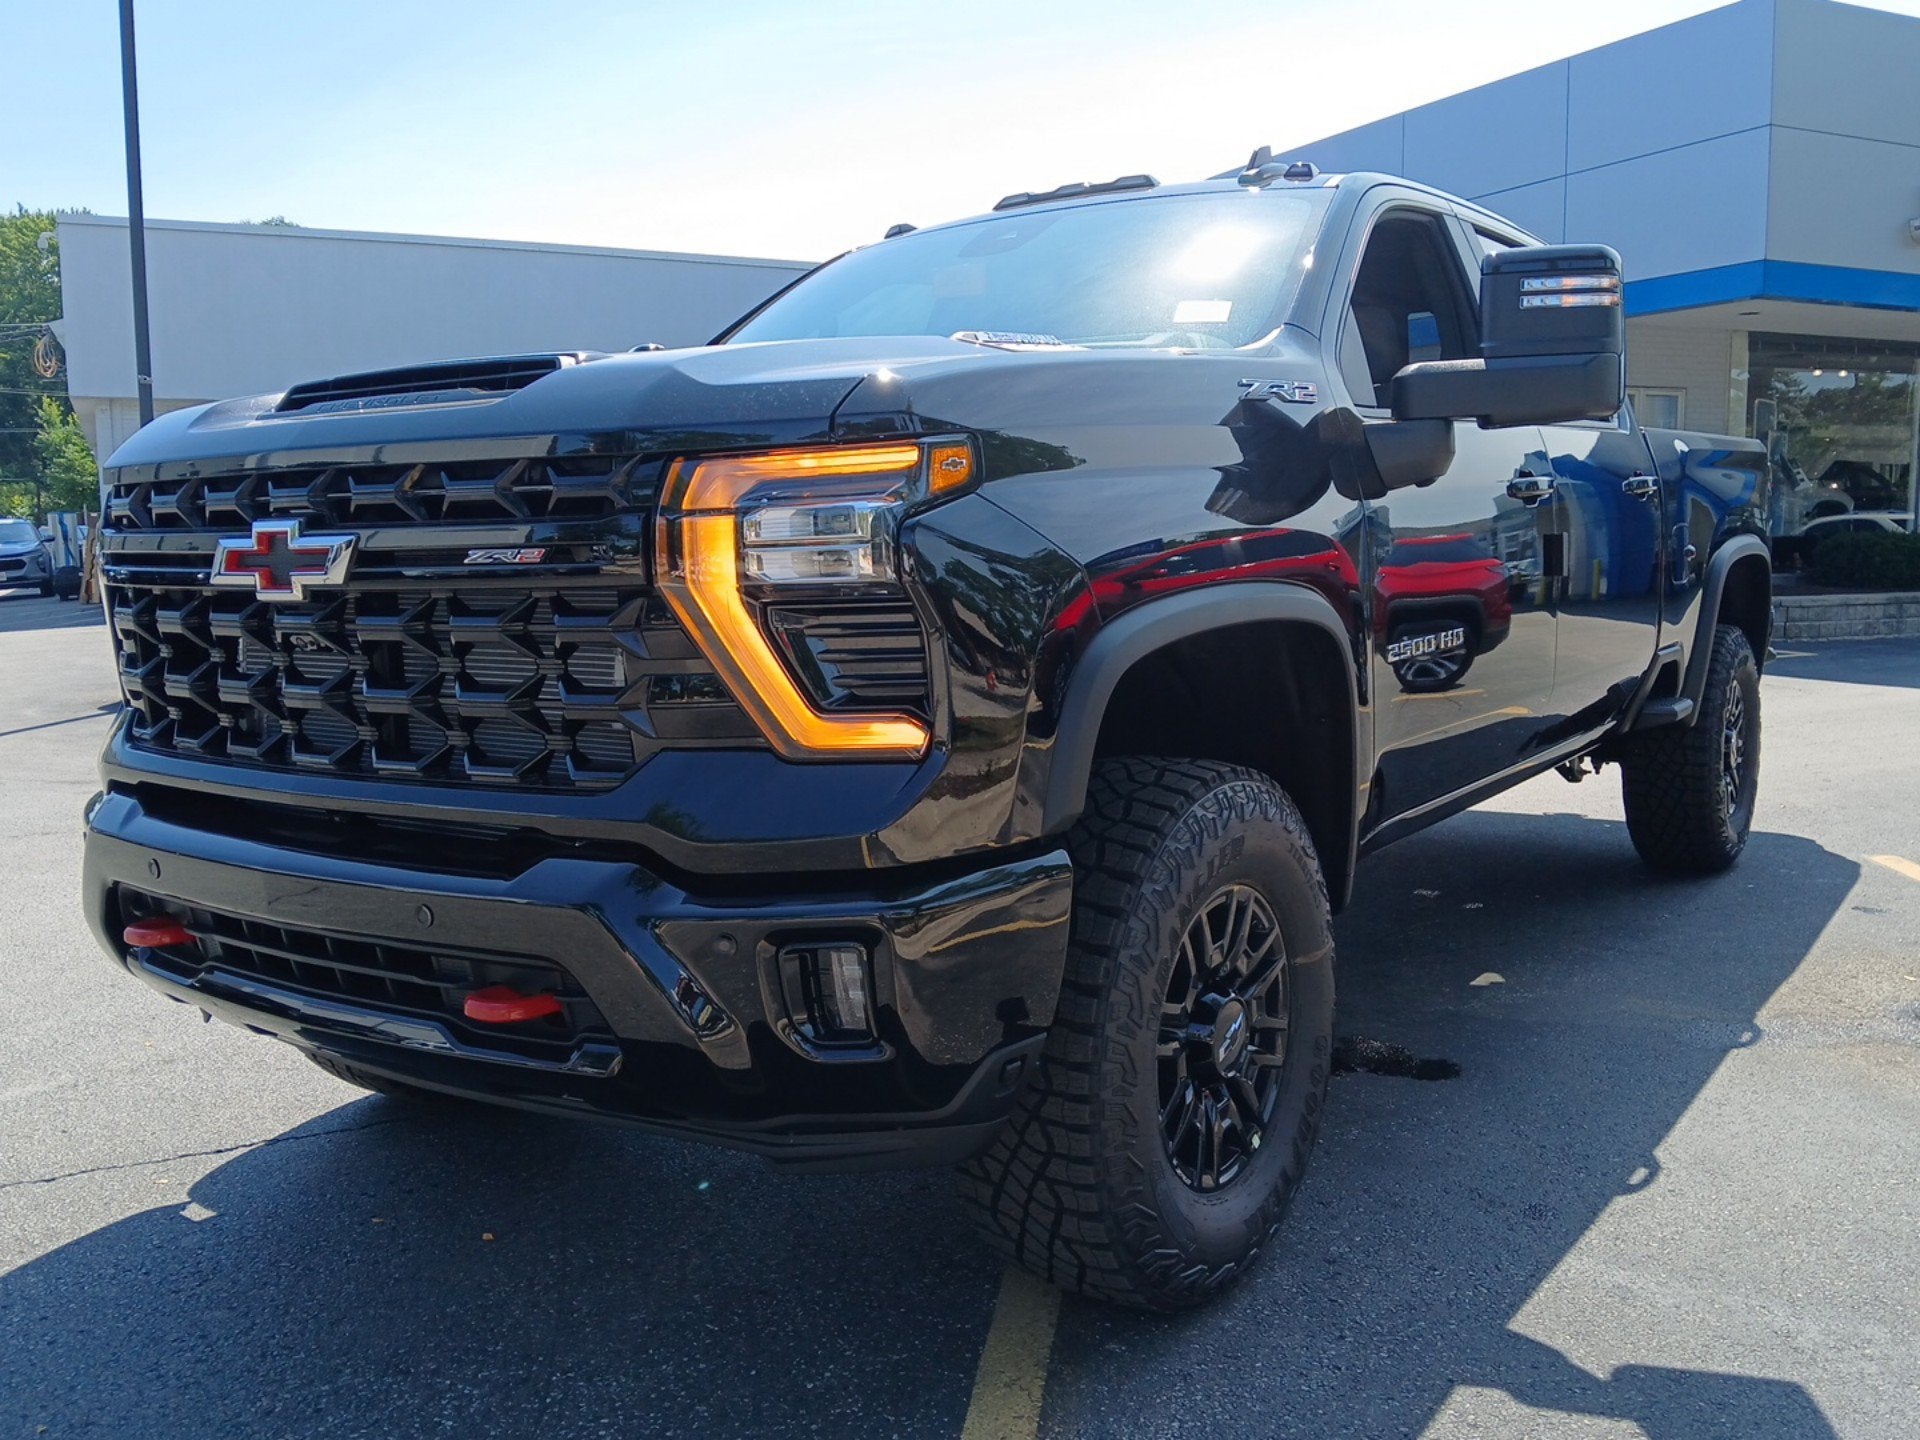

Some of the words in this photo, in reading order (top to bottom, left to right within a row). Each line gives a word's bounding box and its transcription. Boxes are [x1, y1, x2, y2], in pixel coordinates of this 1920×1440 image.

[1237, 378, 1317, 404] ZR2
[463, 548, 546, 564] ZR2
[1387, 634, 1436, 663] 2500
[1439, 627, 1465, 649] HD
